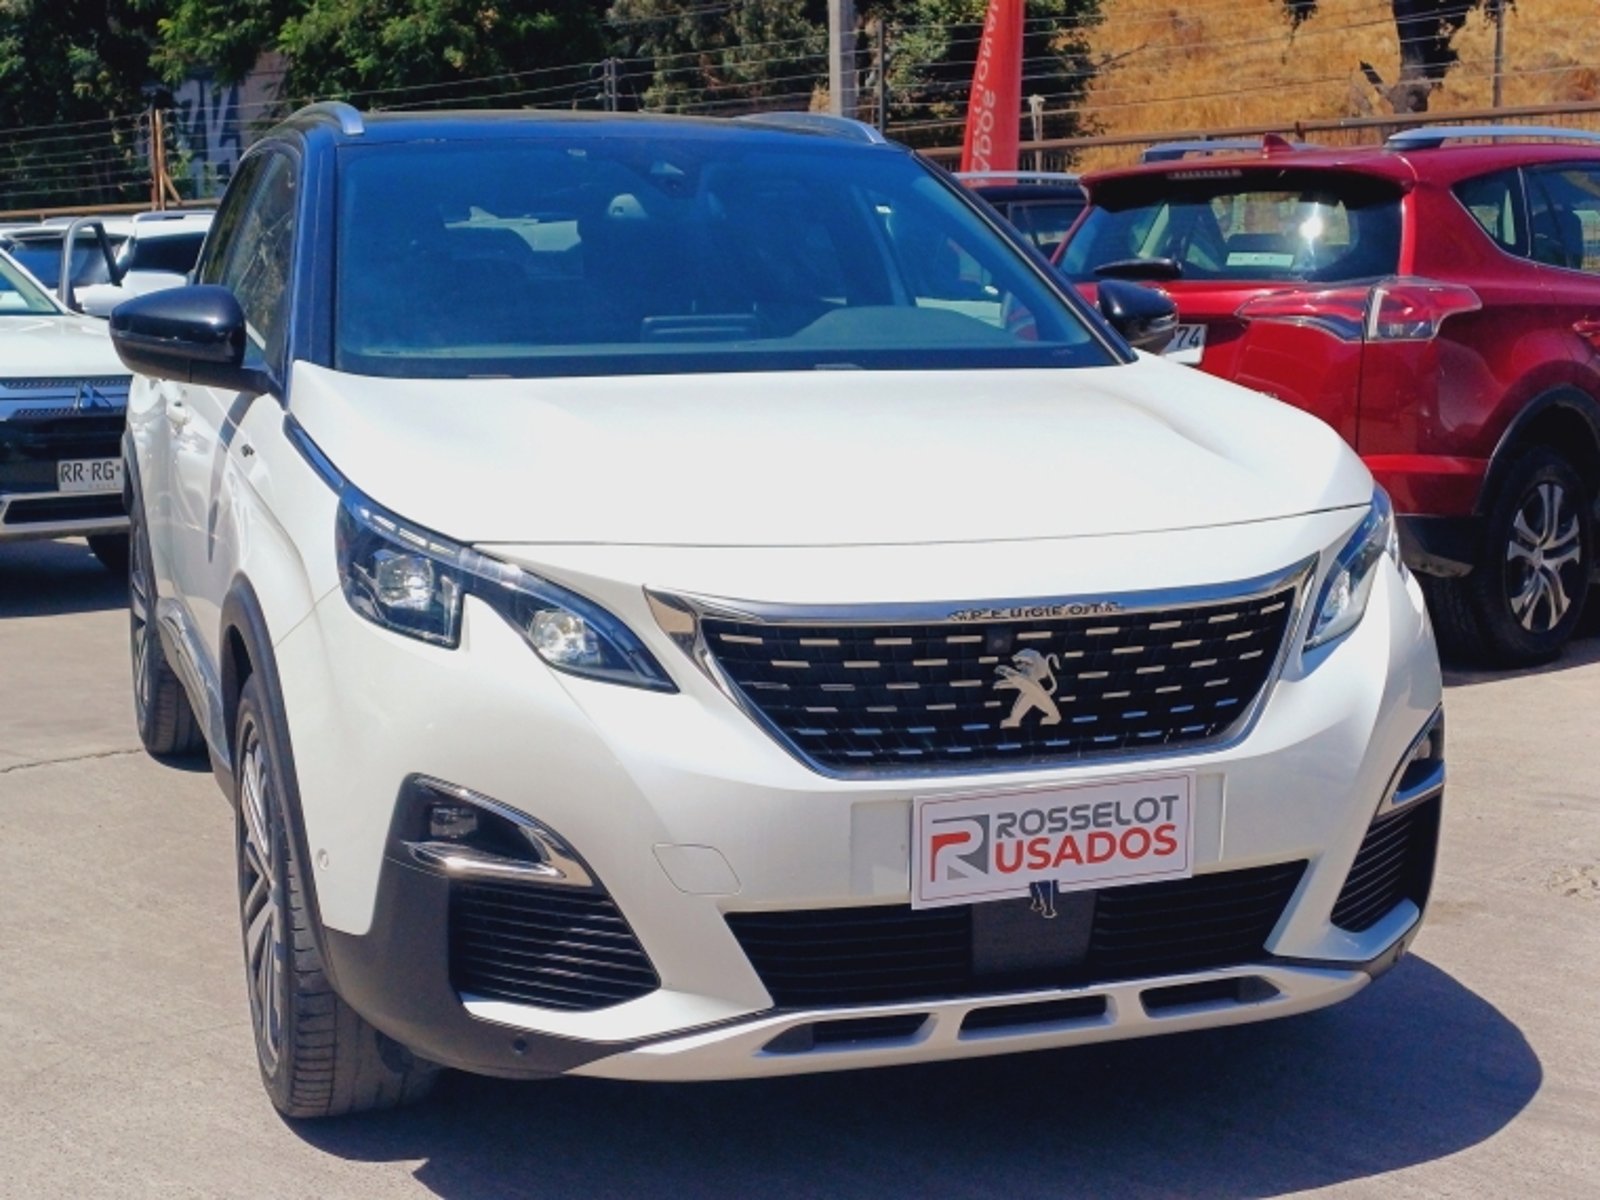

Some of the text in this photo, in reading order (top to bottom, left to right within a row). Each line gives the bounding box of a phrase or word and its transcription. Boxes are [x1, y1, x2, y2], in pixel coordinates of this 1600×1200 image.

[970, 603, 1101, 620] PEUGEOT
[996, 795, 1179, 839] ROSSELOT
[995, 823, 1178, 874] USADOS
